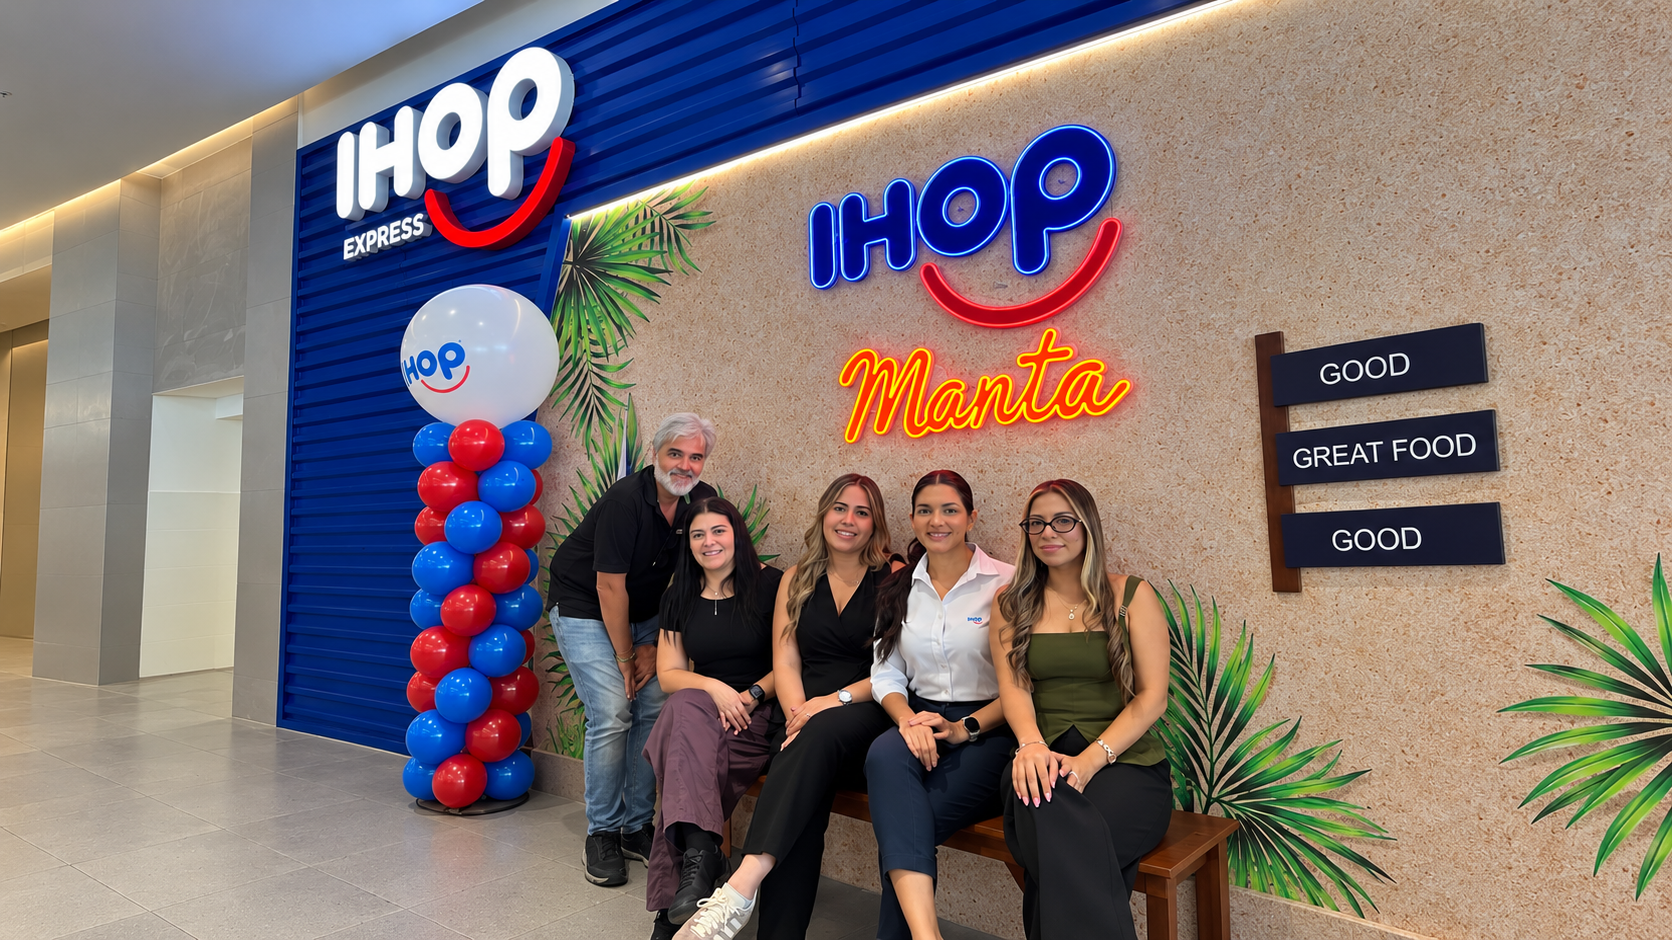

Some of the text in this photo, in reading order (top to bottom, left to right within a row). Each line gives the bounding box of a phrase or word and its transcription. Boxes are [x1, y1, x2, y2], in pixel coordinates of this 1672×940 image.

[336, 46, 575, 221] IHOP
[808, 124, 1118, 290] IHOP
[343, 212, 432, 261] EXPRESS
[838, 328, 1132, 443] Manta
[1319, 352, 1411, 385] GOOD
[1292, 433, 1477, 469] GREAT FOOD
[1331, 526, 1423, 552] GOOD
